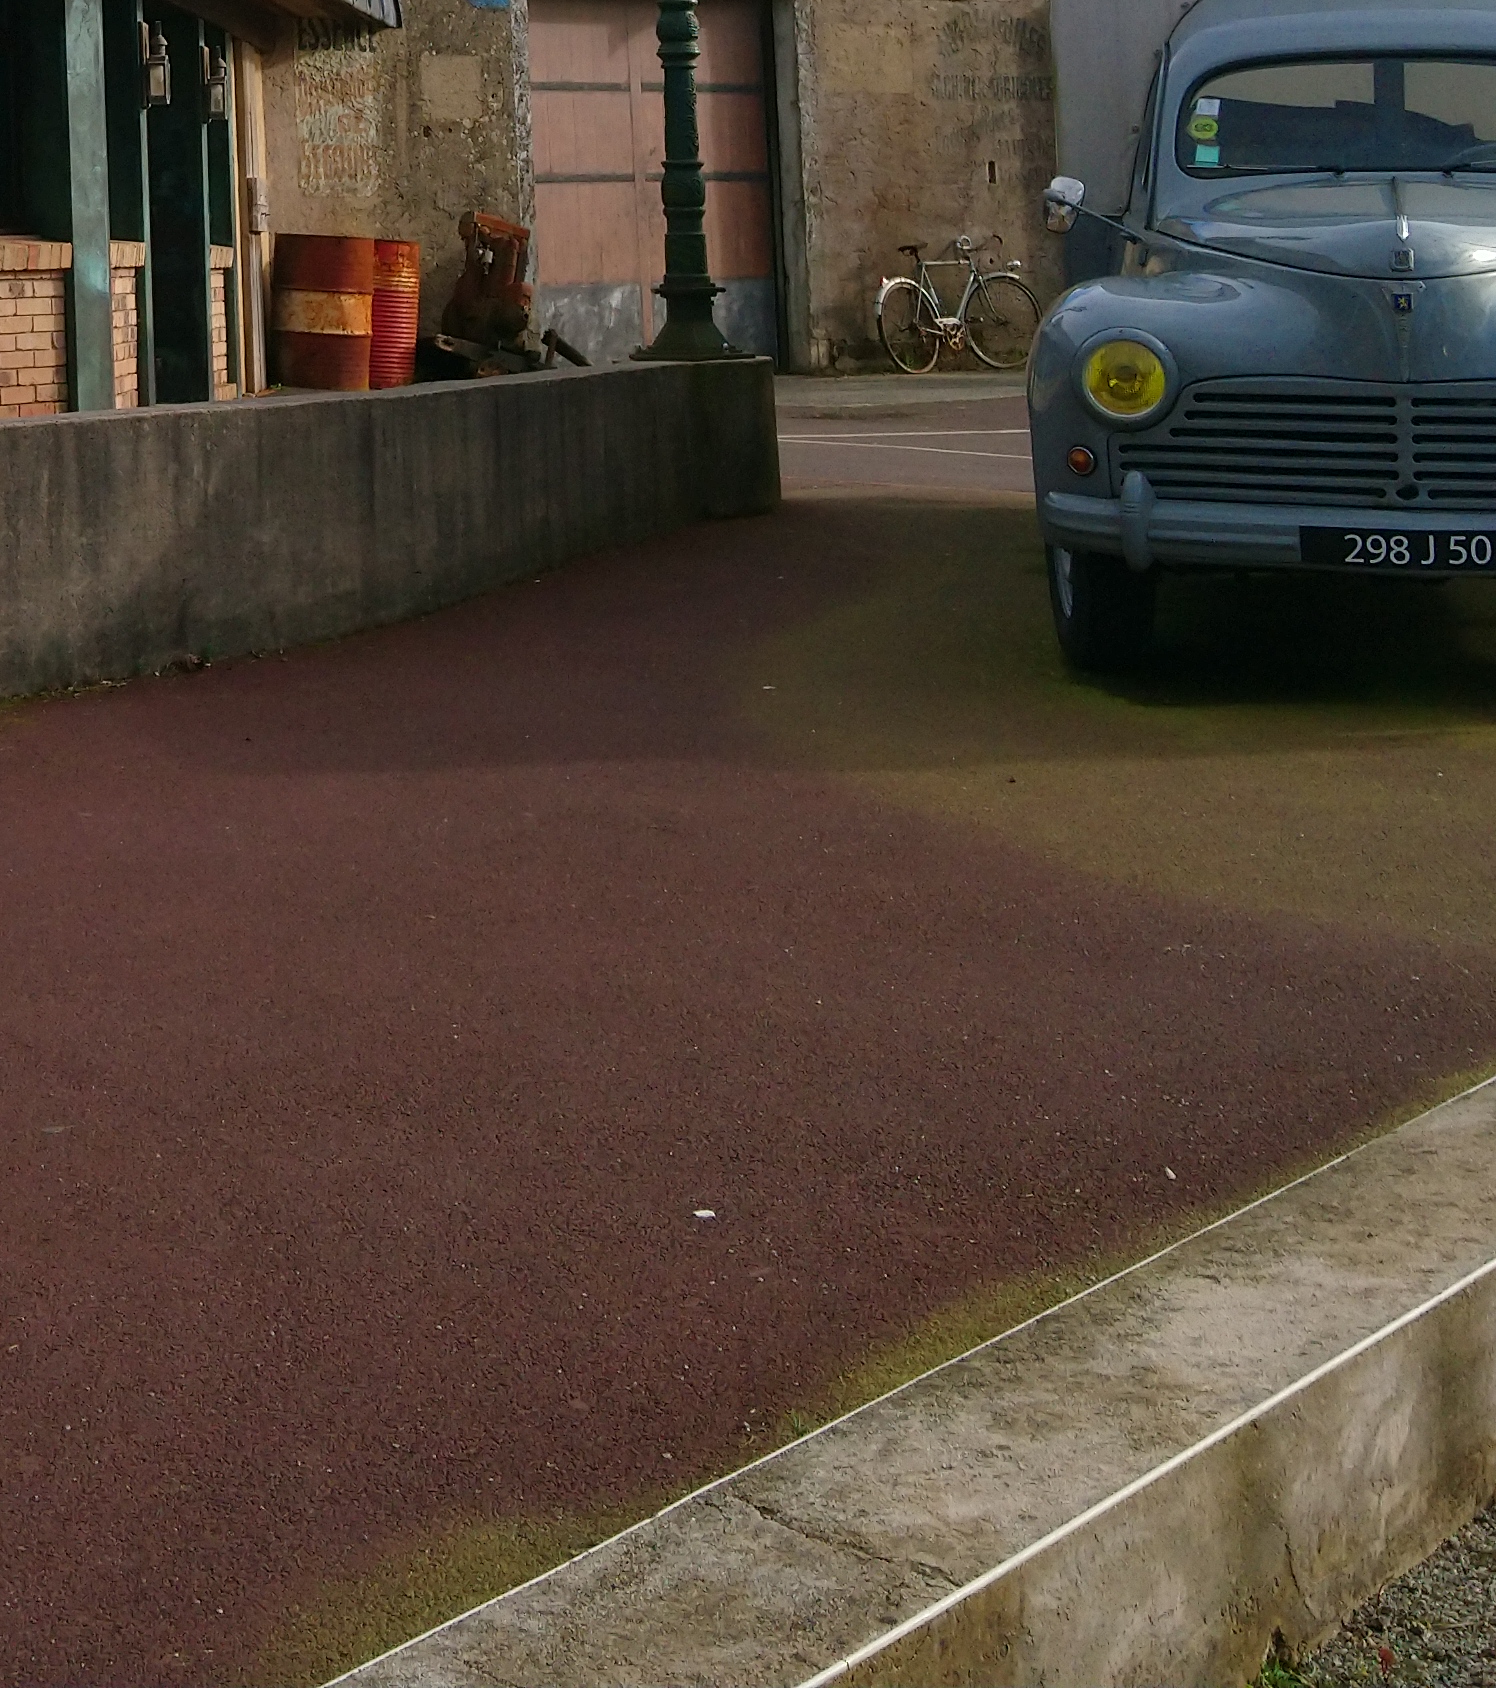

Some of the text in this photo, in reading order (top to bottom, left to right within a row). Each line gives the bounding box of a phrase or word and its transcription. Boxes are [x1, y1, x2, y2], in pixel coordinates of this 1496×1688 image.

[1344, 534, 1493, 565] 298 J 50
